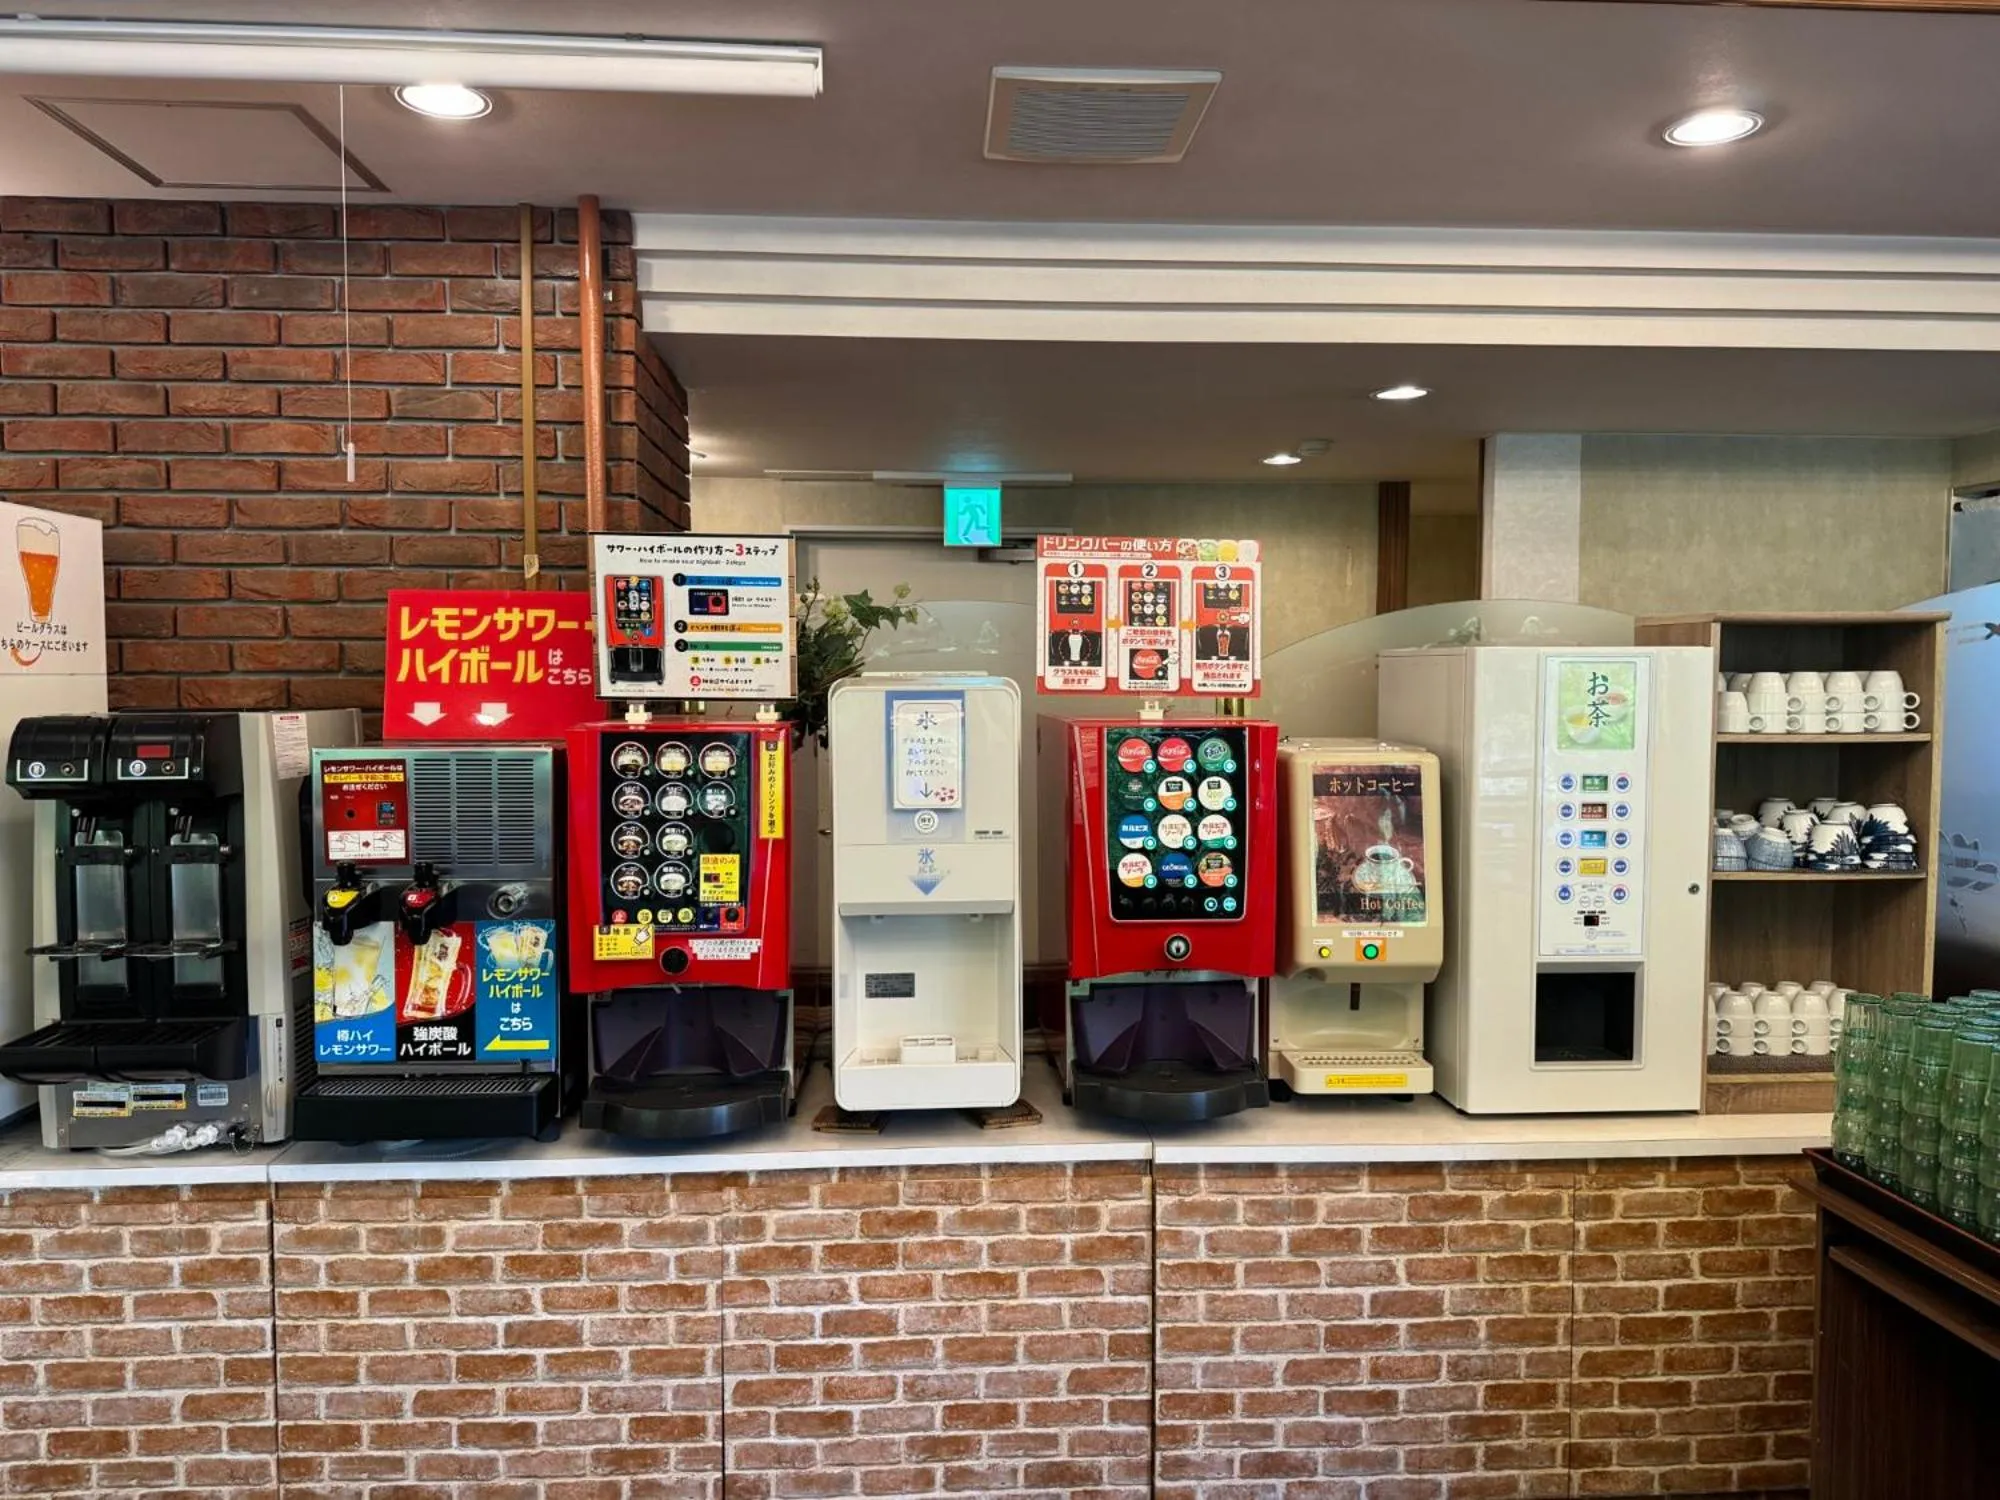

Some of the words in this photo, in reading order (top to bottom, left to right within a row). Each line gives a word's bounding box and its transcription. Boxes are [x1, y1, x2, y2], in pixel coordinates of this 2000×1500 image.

[1043, 537, 1172, 552] ドリンクバーの使い方
[1145, 565, 1154, 576] 2
[1218, 566, 1227, 578] 3
[17, 621, 67, 635] ビールグラスは
[396, 645, 544, 683] ハイボール
[548, 668, 592, 685] こちら
[1587, 672, 1611, 728] お茶
[1329, 777, 1415, 793] ホットコーヒー
[1360, 898, 1381, 910] Hot
[1385, 897, 1424, 911] Coffee
[481, 968, 550, 983] レモンサワー
[489, 984, 543, 999] ハイボール
[511, 1002, 521, 1013] は
[499, 1017, 533, 1031] こちら
[337, 1029, 373, 1042] 樽ハイ
[413, 1026, 458, 1042] 強炭酸
[320, 1043, 392, 1056] レモンサワー
[400, 1042, 471, 1057] ハイボール
